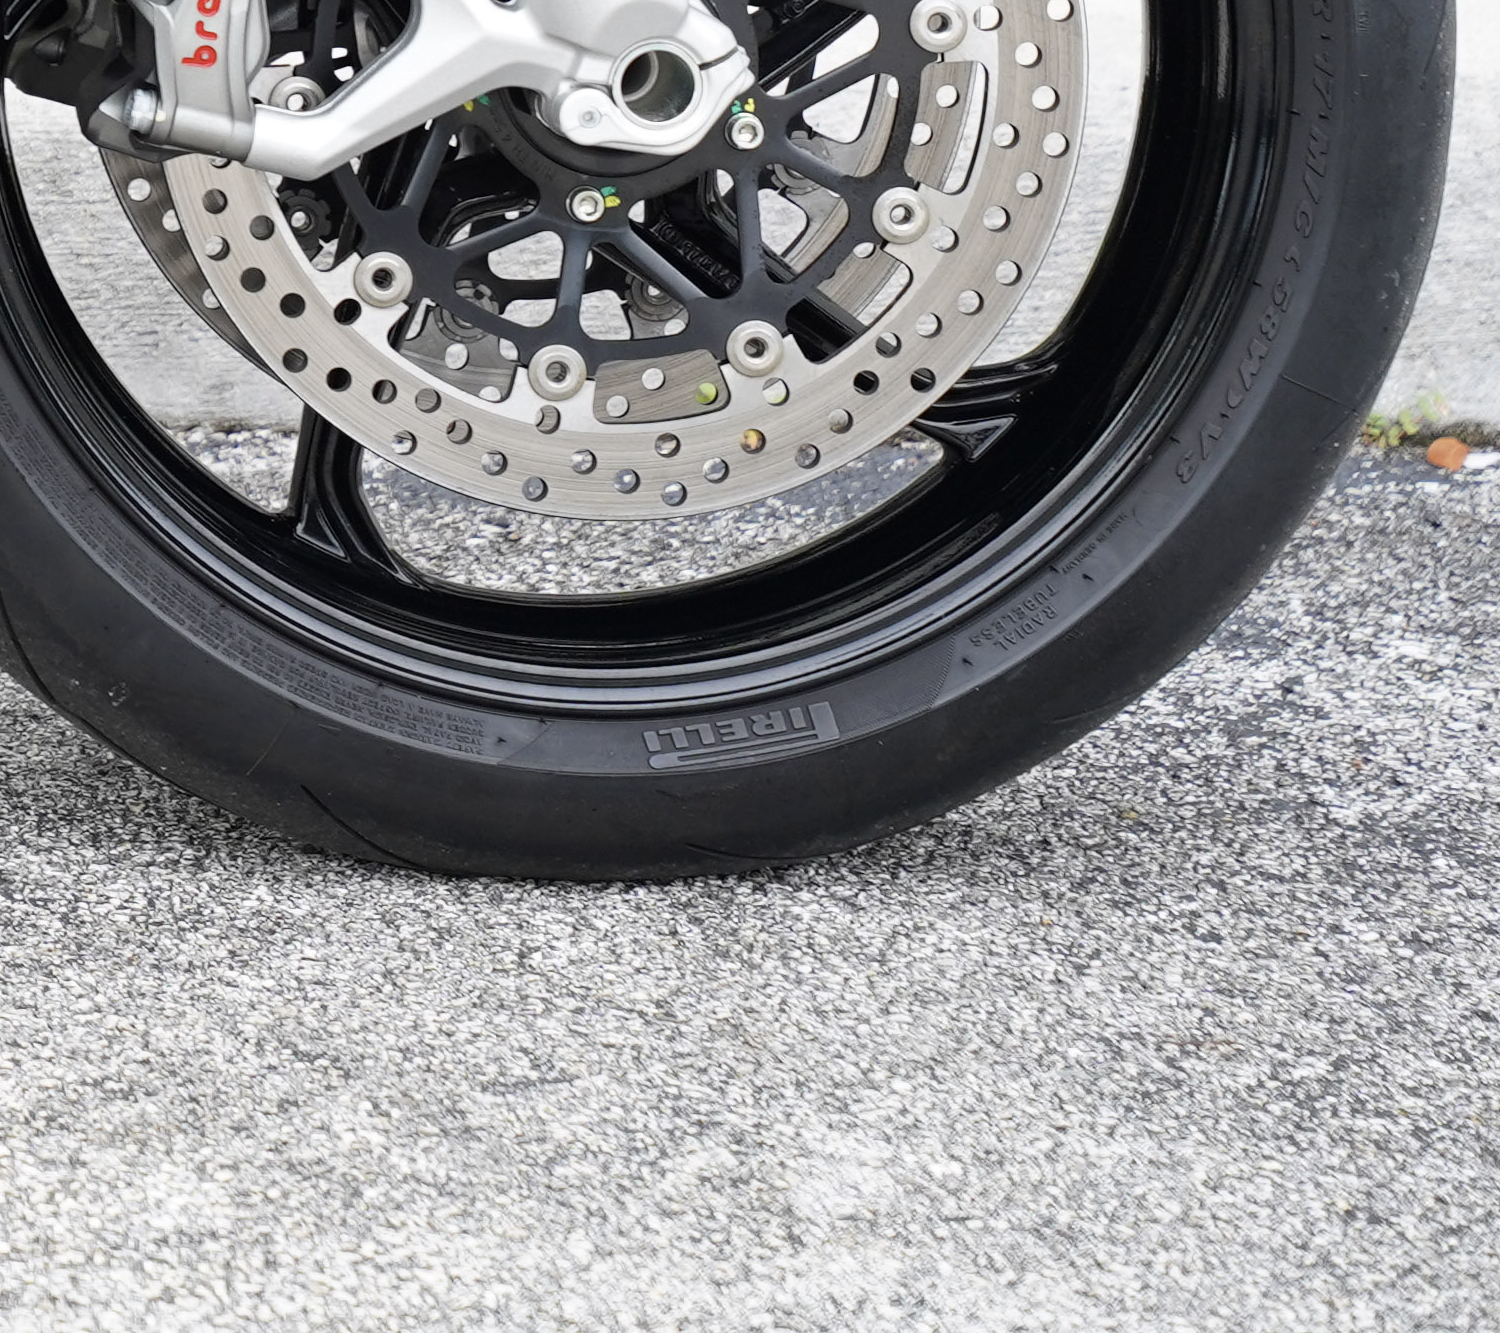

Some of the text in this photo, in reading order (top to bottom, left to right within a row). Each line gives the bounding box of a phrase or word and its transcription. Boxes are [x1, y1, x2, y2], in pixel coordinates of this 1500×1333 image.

[966, 579, 1060, 651] TUBELESS
[990, 601, 1059, 656] RADIAL
[641, 698, 842, 770] PIRELLI
